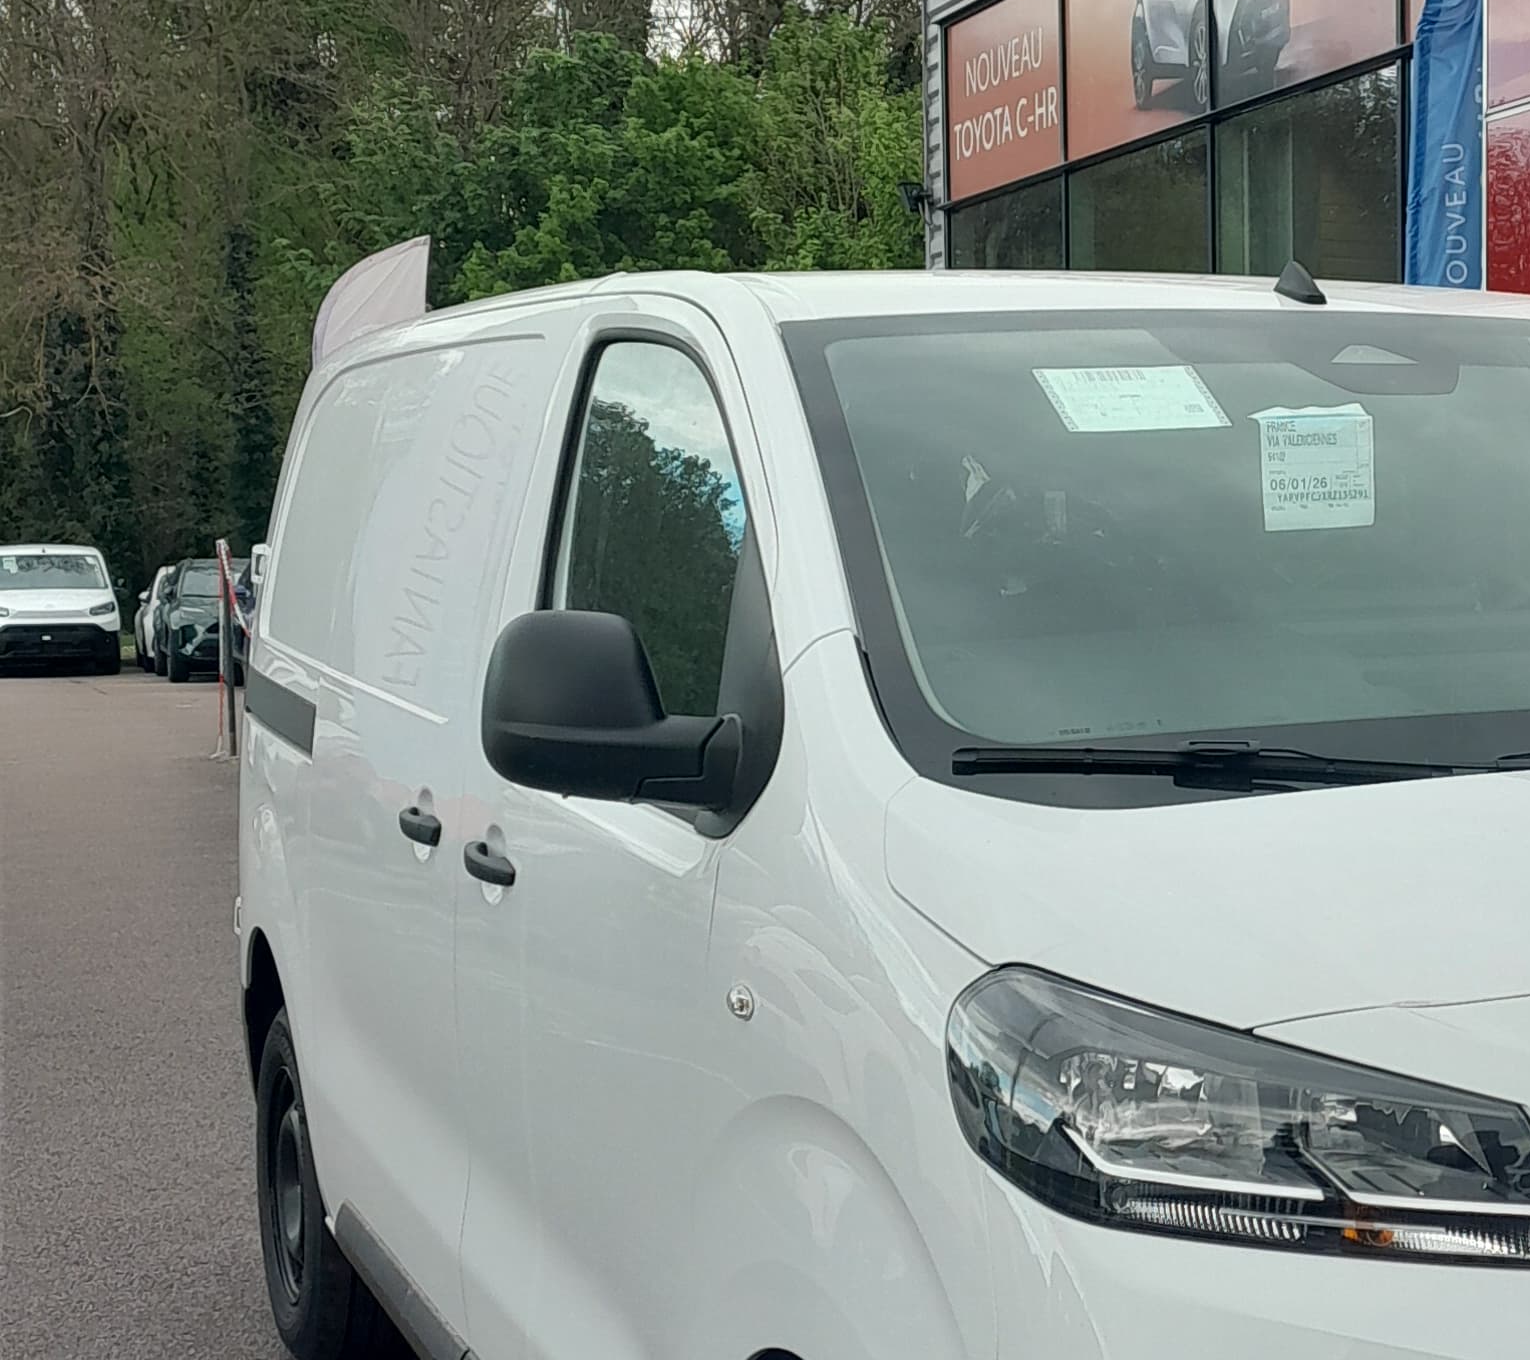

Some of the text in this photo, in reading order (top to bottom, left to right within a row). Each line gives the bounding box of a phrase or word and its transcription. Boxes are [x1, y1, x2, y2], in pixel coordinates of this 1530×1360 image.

[966, 27, 1042, 97] NOUVEAU
[954, 86, 1058, 161] TOYOTA C-HR
[1270, 477, 1328, 491] 06/01/26
